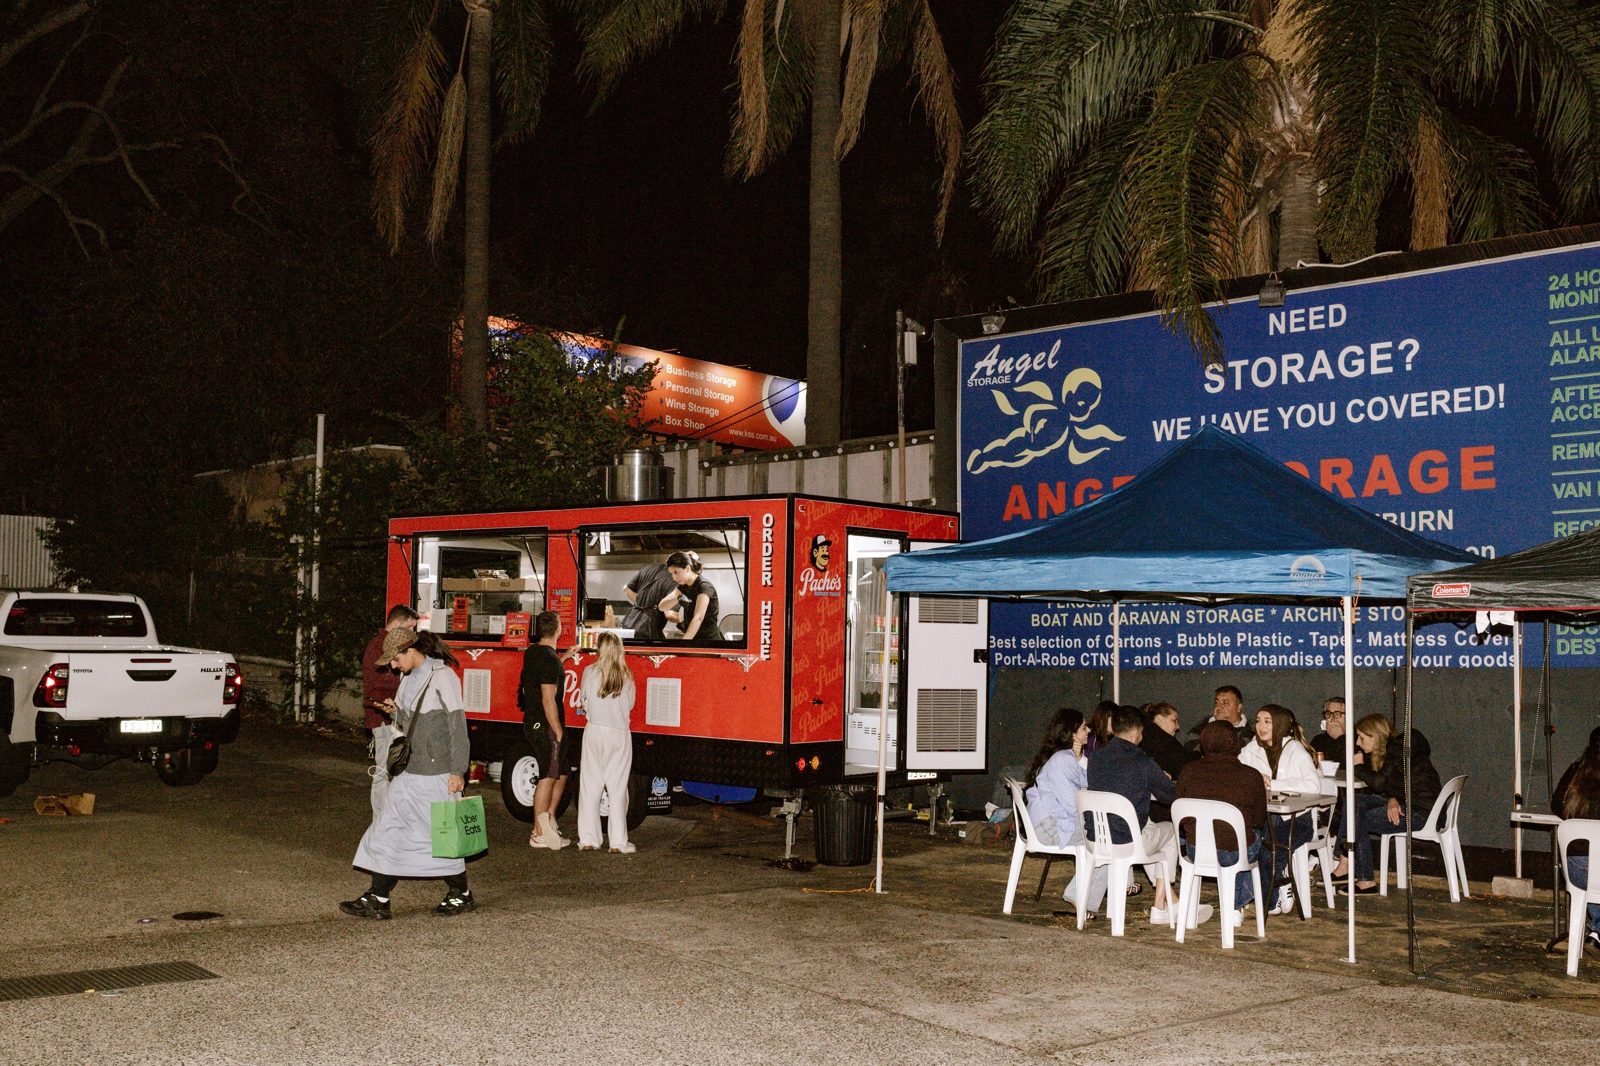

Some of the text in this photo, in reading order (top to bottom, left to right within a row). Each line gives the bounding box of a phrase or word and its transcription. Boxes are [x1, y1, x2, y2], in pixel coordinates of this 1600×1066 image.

[1548, 274, 1570, 291] 24
[1549, 287, 1600, 309] MONI
[1269, 303, 1347, 336] NEED
[1549, 328, 1587, 347] ALL
[969, 338, 1062, 383] Angel
[1203, 337, 1420, 394] STORAGE?
[1549, 345, 1600, 366] ALAR
[666, 364, 737, 388] Business Storage
[967, 375, 1012, 388] STORAGE
[665, 381, 735, 404] Personal Storage
[1550, 384, 1600, 404] AFTE
[665, 397, 720, 418] Wine Storage
[1152, 417, 1191, 442] WE
[1277, 401, 1337, 430] YOU
[1346, 383, 1505, 424] COVERED!
[665, 415, 705, 432] Box Shop
[728, 428, 777, 442] www.kss.com.au
[1284, 445, 1496, 498] RAGE
[1002, 475, 1137, 521] ANG
[1552, 481, 1592, 499] VAN
[1553, 520, 1600, 538] REC
[760, 513, 775, 661] ORDER HERE
[799, 567, 842, 597] Pacho's
[1435, 586, 1462, 595] Coleman
[1031, 613, 1069, 627] BOAT
[1072, 612, 1104, 627] AND
[1108, 610, 1181, 626] CARAVAN
[1186, 608, 1265, 624] STORAGE
[1368, 606, 1406, 621] STO
[989, 635, 1017, 649] Best
[1020, 635, 1082, 649] selection
[1086, 634, 1102, 649] of
[1105, 634, 1162, 649] Cartons
[1177, 633, 1231, 648] Bubble
[1236, 632, 1292, 647] Plastic
[1309, 631, 1346, 650] Tape
[1368, 631, 1447, 647] Mattess
[1454, 630, 1522, 646] Cover
[994, 652, 1076, 666] Port-A-Robe
[1134, 652, 1161, 667] and
[1166, 651, 1194, 667] lots
[1199, 651, 1215, 666] of
[1220, 651, 1324, 666] Merchandise
[1353, 654, 1404, 667] cover
[460, 814, 478, 825] Uber
[464, 825, 481, 835] Eats
